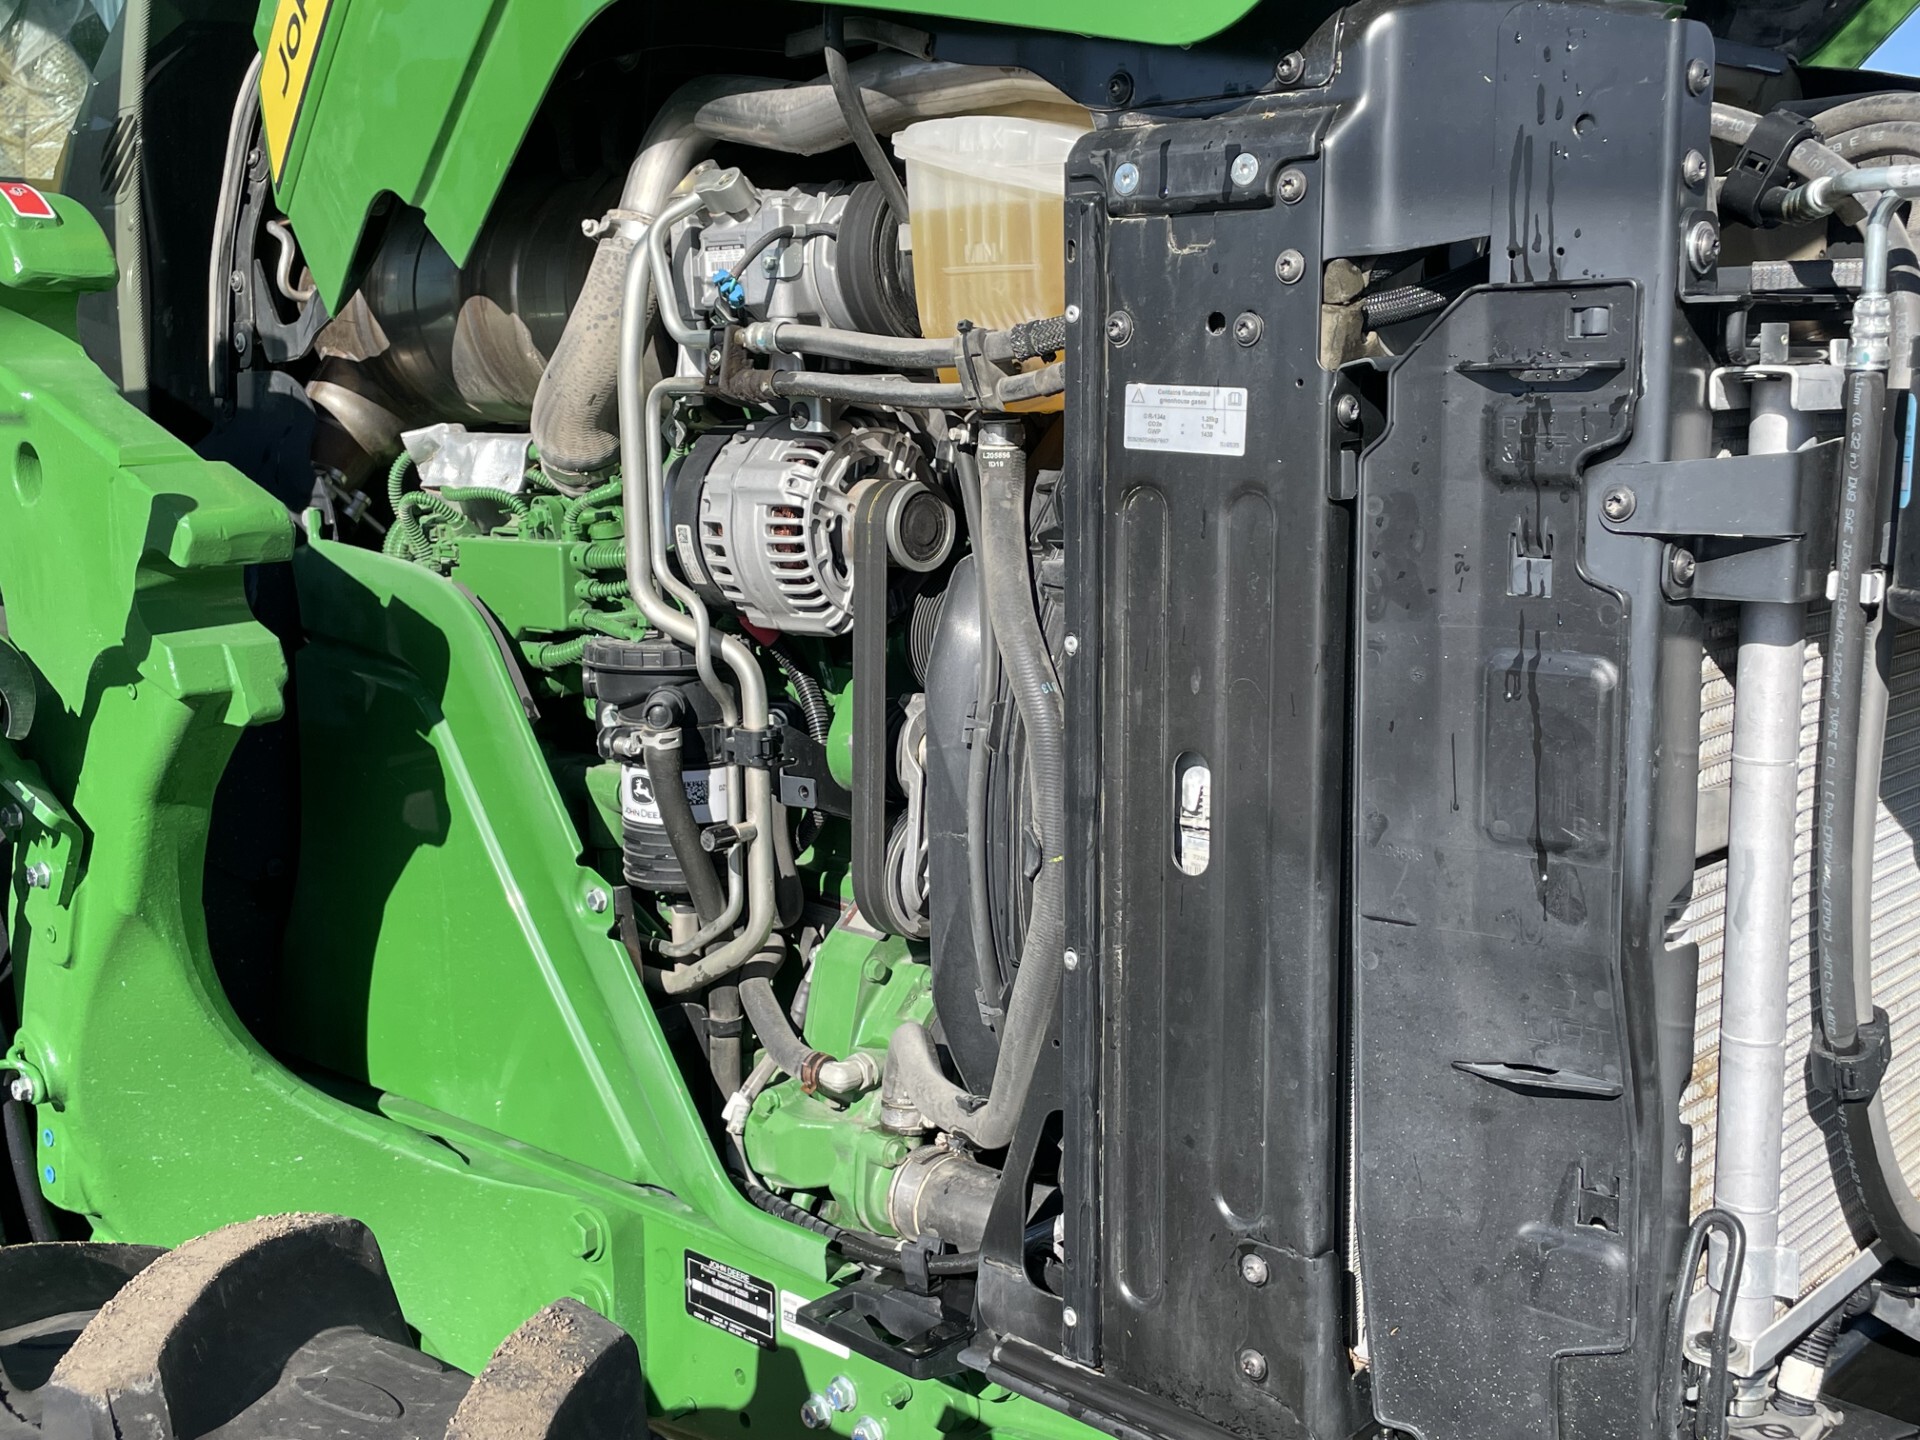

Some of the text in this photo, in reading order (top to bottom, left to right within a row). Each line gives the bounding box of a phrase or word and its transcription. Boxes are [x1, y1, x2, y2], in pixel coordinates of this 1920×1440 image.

[1157, 388, 1181, 396] Contains
[1159, 397, 1207, 406] greenhouse gases
[640, 808, 661, 819] DEE
[709, 1260, 750, 1284] JOHN DEERE
